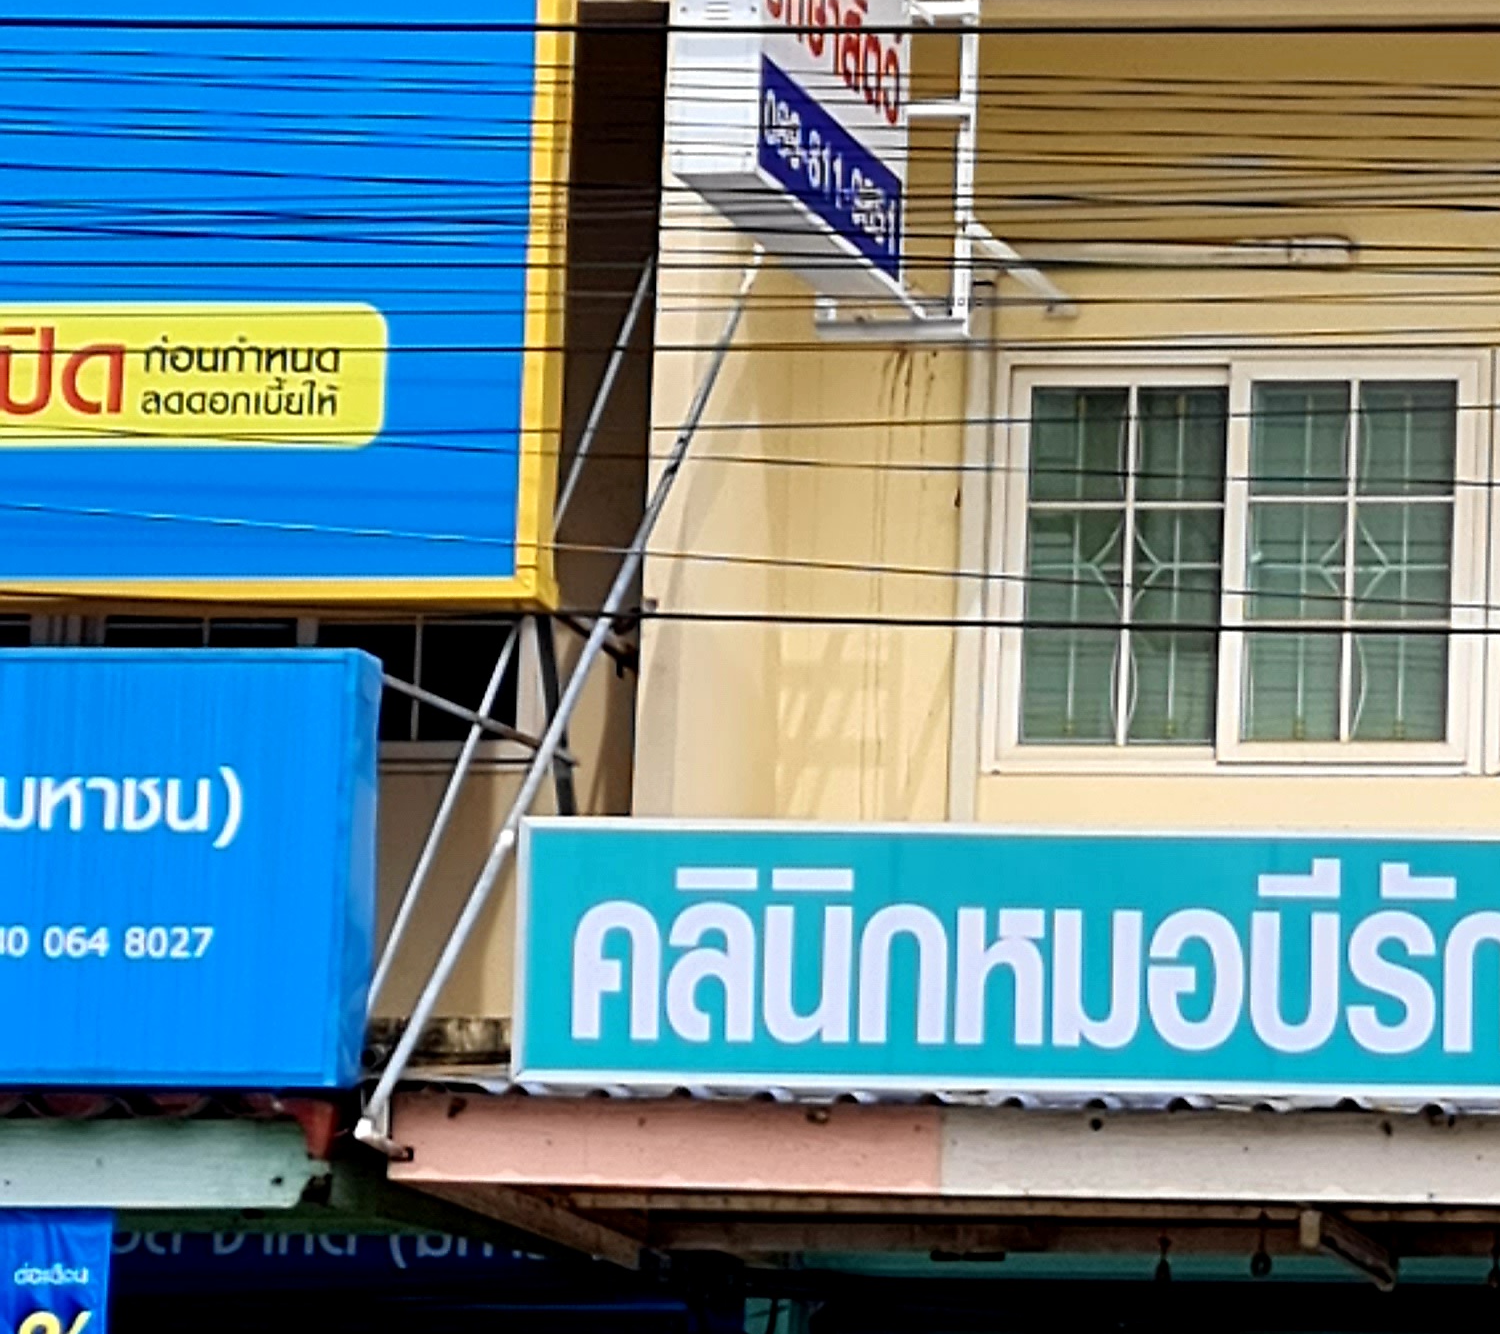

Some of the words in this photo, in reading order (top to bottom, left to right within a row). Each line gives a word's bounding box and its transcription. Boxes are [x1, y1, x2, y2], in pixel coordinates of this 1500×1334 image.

[143, 334, 341, 373] ก่อนกำหนด
[141, 377, 339, 416] ลดดอกเบี้ยให้
[43, 925, 111, 958] 064
[124, 925, 215, 959] 8027
